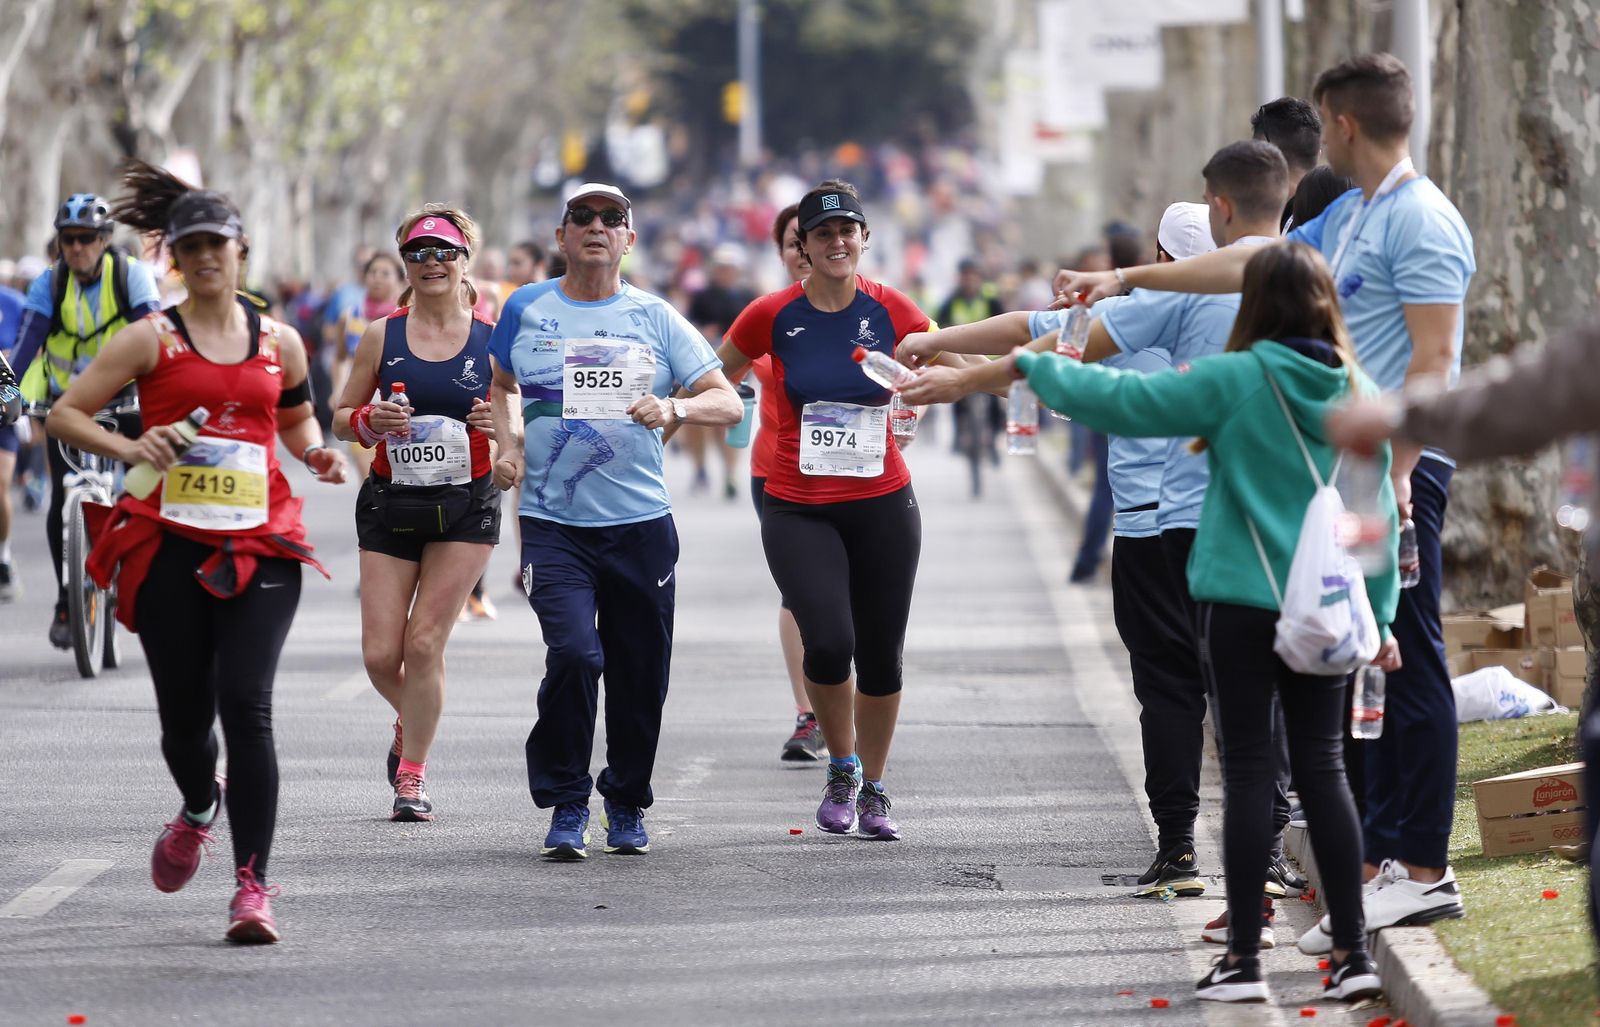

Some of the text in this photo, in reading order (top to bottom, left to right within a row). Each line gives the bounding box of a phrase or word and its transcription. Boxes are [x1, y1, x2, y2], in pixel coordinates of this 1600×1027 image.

[573, 370, 623, 388] 9525
[564, 406, 578, 416] edp
[811, 429, 857, 448] 9974
[390, 445, 446, 463] 10050
[801, 462, 814, 472] edp
[179, 473, 235, 494] 7419
